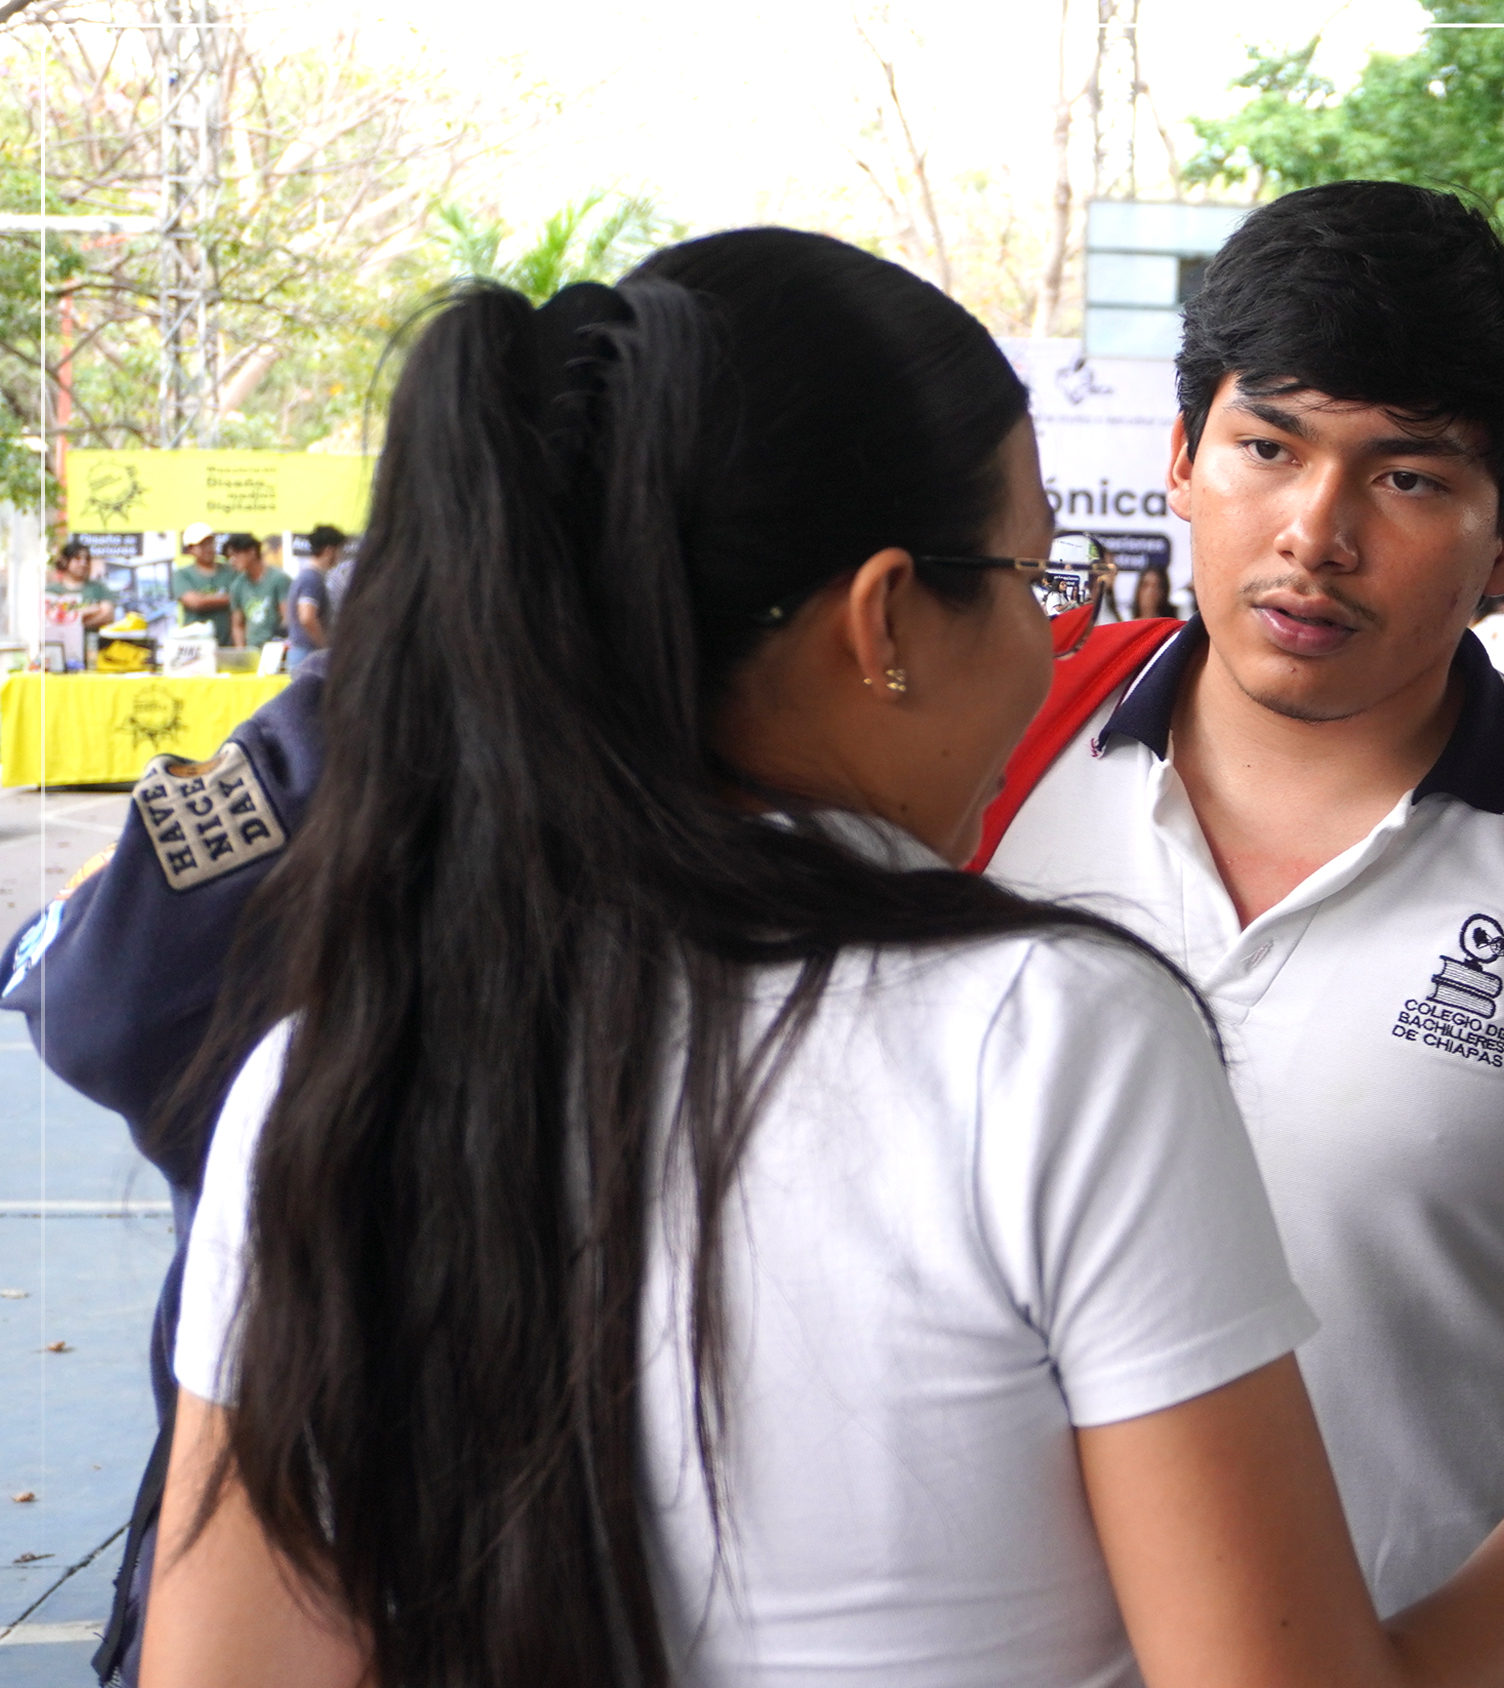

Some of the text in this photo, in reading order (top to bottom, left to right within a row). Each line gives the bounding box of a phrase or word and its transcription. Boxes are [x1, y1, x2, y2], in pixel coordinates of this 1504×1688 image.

[1045, 477, 1167, 517] ónica
[140, 784, 198, 876] HAVE
[180, 777, 235, 862] NICE
[218, 777, 272, 846] DAY
[1405, 998, 1483, 1031] COLEGIO
[1392, 1024, 1504, 1068] DE CHIAPAS
